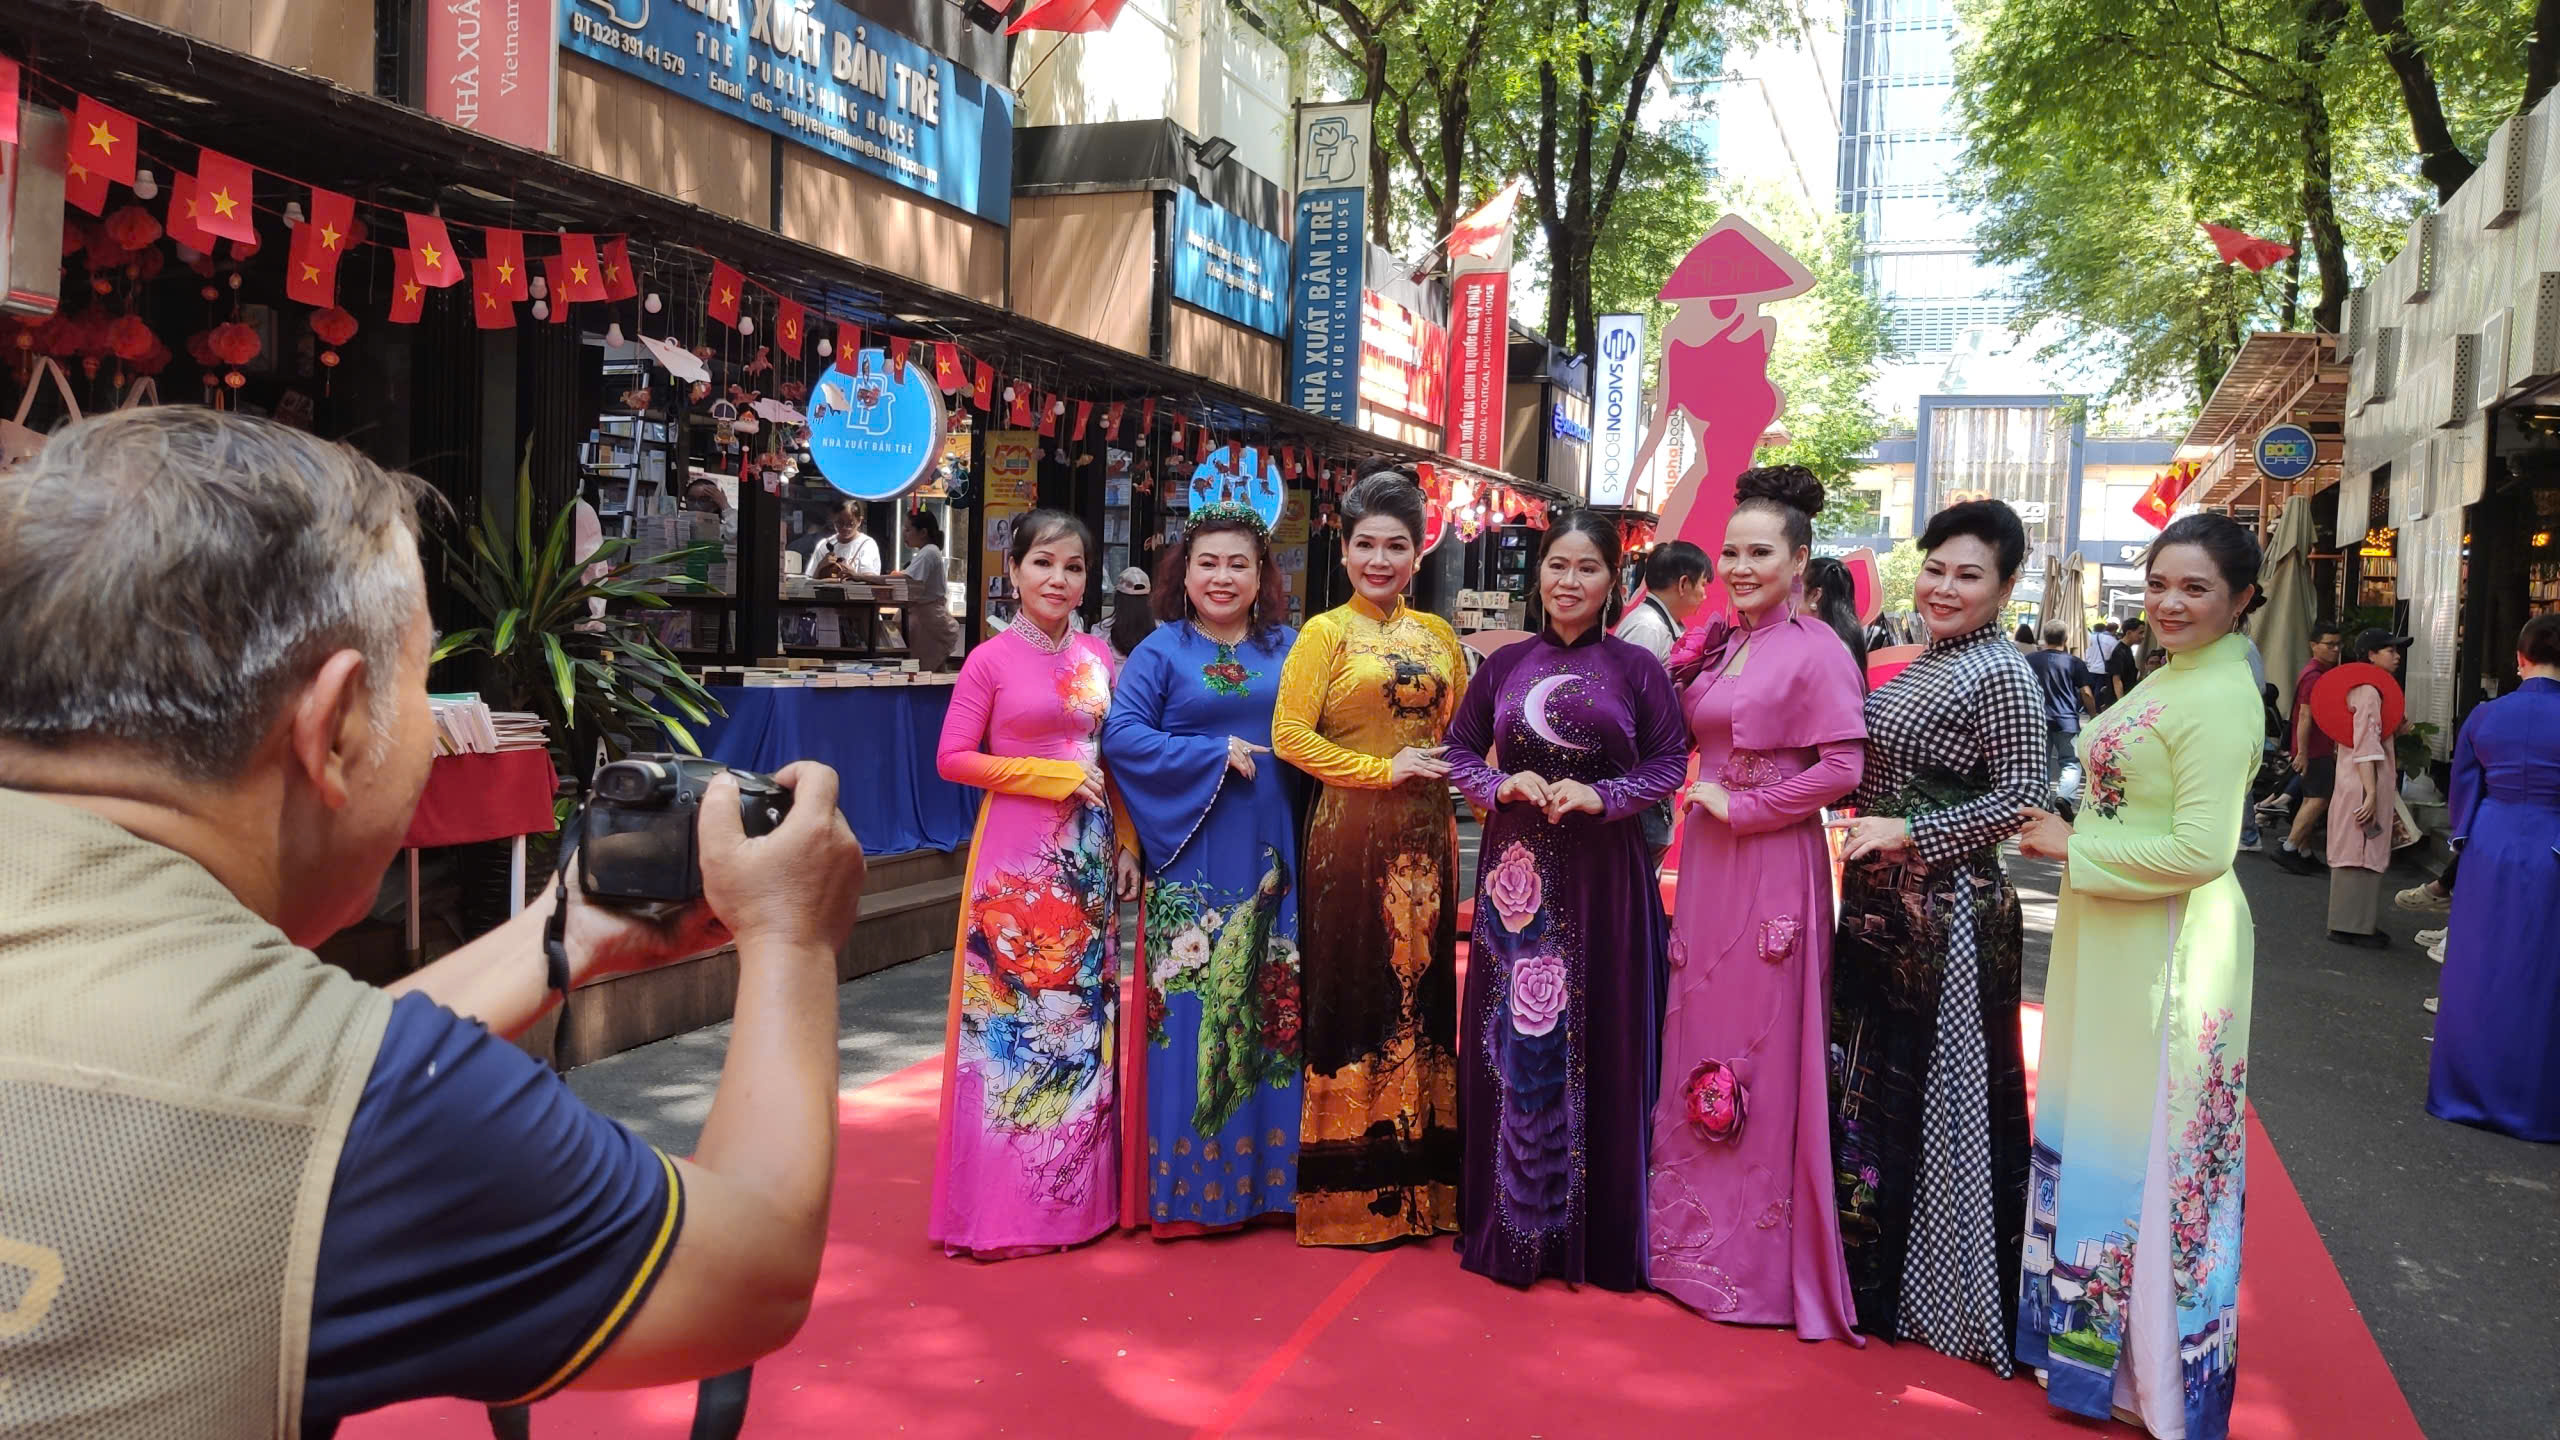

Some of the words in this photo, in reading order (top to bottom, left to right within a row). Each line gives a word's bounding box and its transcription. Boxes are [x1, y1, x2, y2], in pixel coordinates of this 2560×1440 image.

[621, 33, 643, 58] 391
[646, 45, 660, 65] 41
[663, 51, 686, 76] 579
[708, 71, 746, 102] Email:
[696, 31, 733, 68] TRE
[747, 54, 858, 123] PUBLISHING
[865, 107, 915, 149] HOUSE
[832, 26, 887, 100] BẢN
[894, 62, 939, 126] TRẺ
[1303, 200, 1333, 245] TRẺ
[1336, 197, 1349, 254] HOUSE
[1301, 250, 1332, 300] BẢN
[1485, 284, 1496, 315] HOUSE
[1299, 307, 1330, 365] XUẤT
[1332, 267, 1348, 379] PUBLISHING
[1466, 319, 1480, 334] GIA
[1482, 317, 1493, 369] PUBLISHING
[1298, 370, 1328, 415] NHÀ
[1462, 374, 1476, 399] CHÍNH
[1480, 370, 1491, 415] POLITICAL
[1460, 401, 1475, 418] BẢN
[1479, 417, 1489, 460] NATIONAL
[2264, 443, 2309, 456] BOOK
